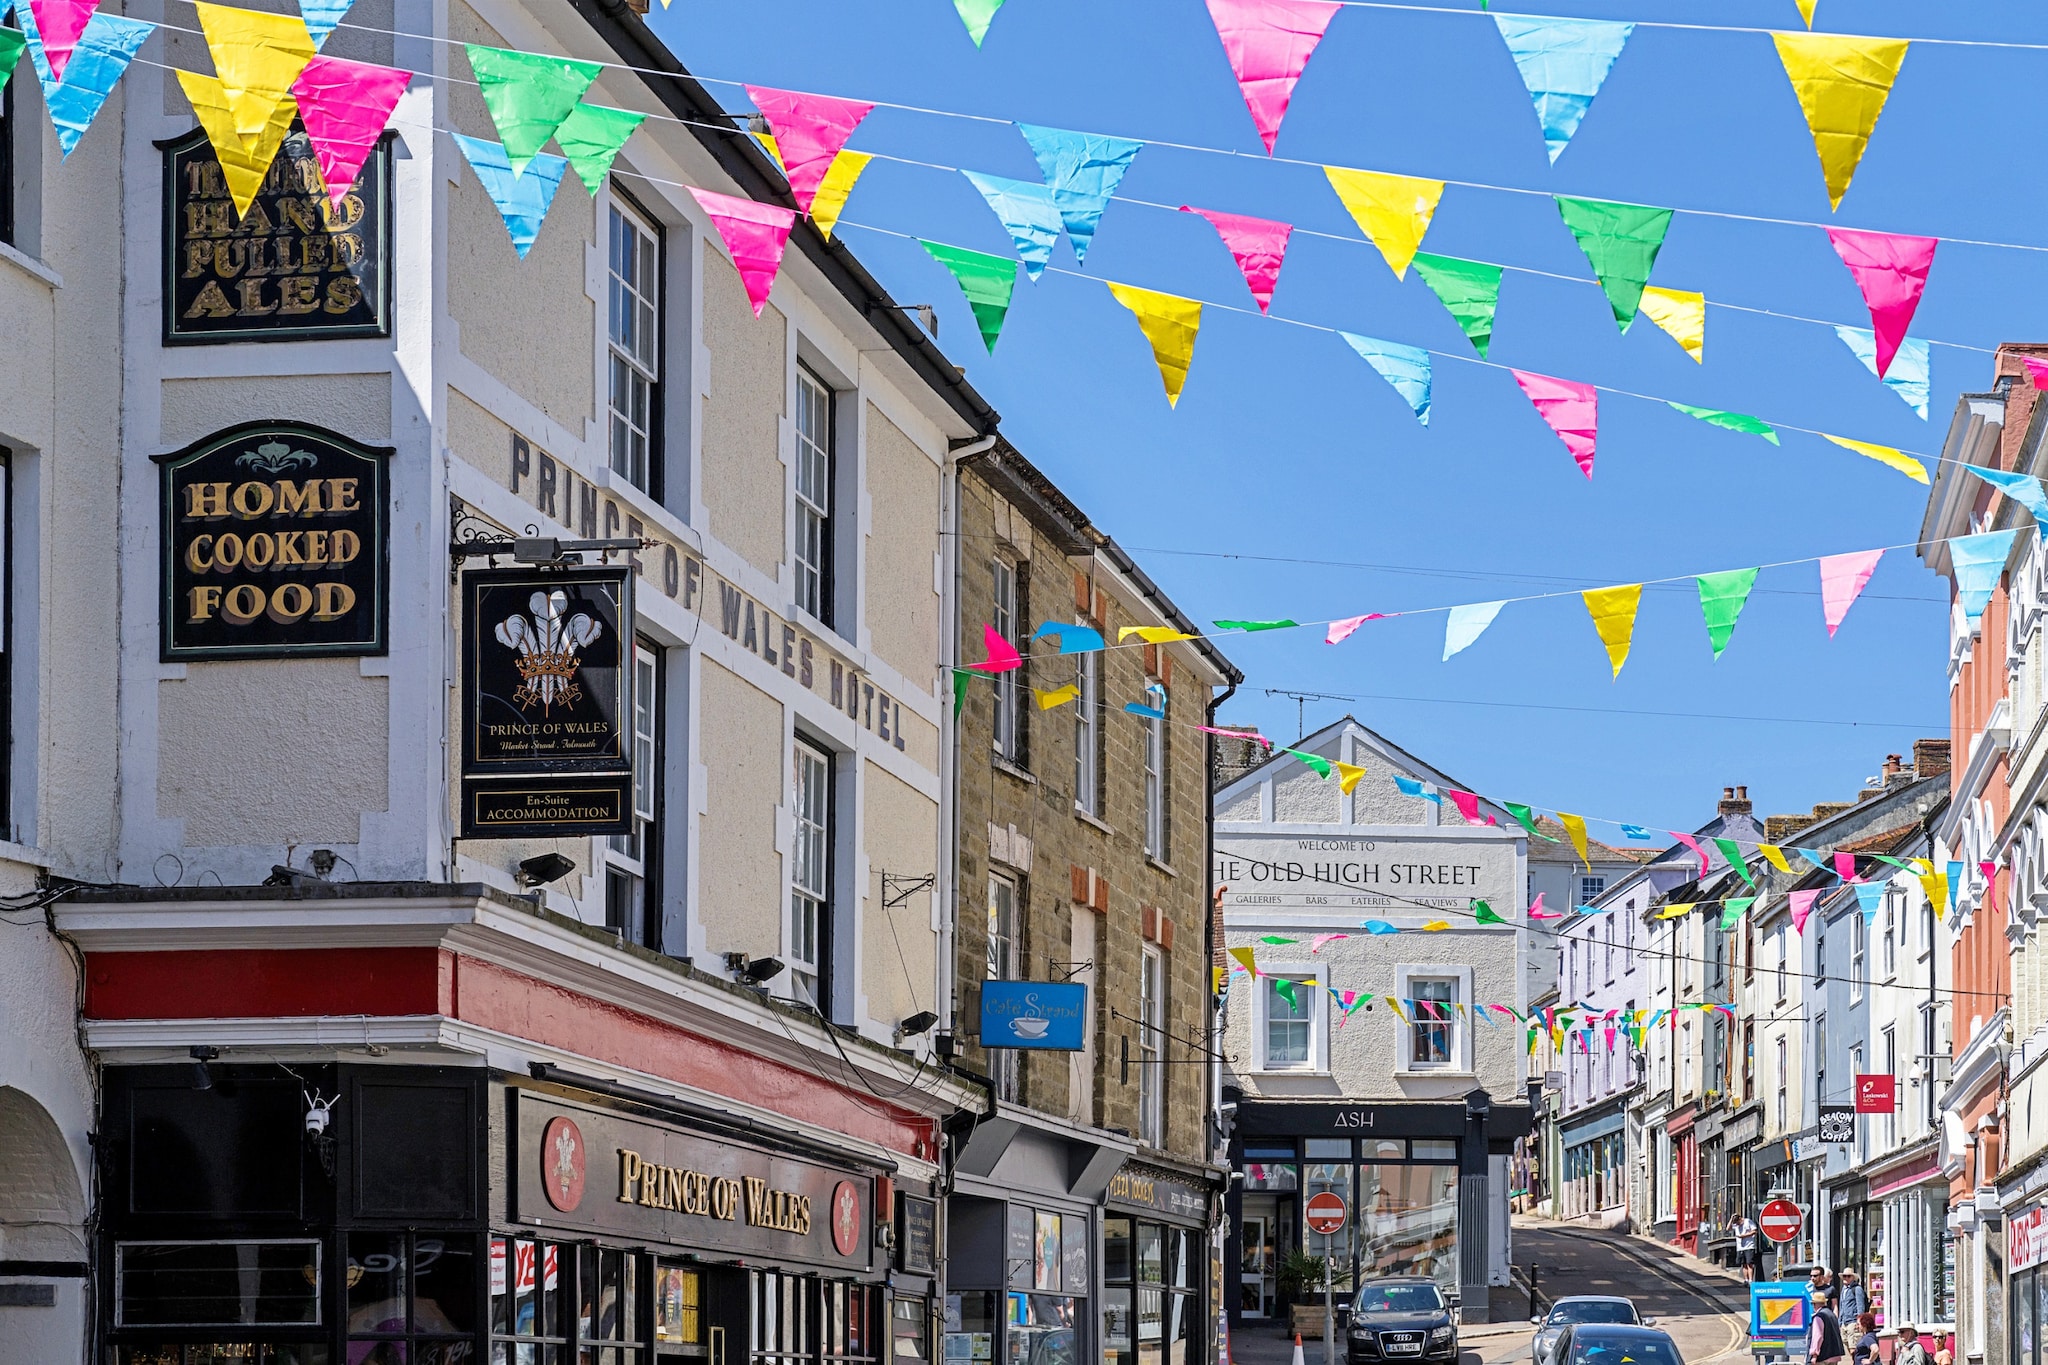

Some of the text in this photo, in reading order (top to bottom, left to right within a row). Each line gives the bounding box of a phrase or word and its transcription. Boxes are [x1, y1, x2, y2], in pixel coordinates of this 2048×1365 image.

[183, 195, 365, 239] HAND
[182, 233, 365, 279] PULLED
[183, 275, 362, 318] ALES
[185, 477, 361, 520] HOME
[187, 528, 361, 572] COOKED
[188, 582, 357, 622] FOOD
[512, 433, 905, 752] PRINCE OF WALES HOTEL
[490, 721, 608, 736] PRINCE OF WALES
[500, 741, 529, 750] Market
[531, 739, 555, 750] Strand
[526, 794, 570, 806] En-Suite
[486, 807, 610, 820] ACCOMMODATION
[1298, 840, 1376, 852] WELCOME TO
[1213, 861, 1481, 885] HE OLD HIGH STREET
[1235, 895, 1458, 908] GALLERIES BARS EATERIES SEA VIEWS
[1334, 1111, 1374, 1128] ASH
[1820, 1111, 1854, 1125] BEACON
[1820, 1127, 1853, 1142] COFFEE
[620, 1149, 811, 1236] PRINCE OF WALES
